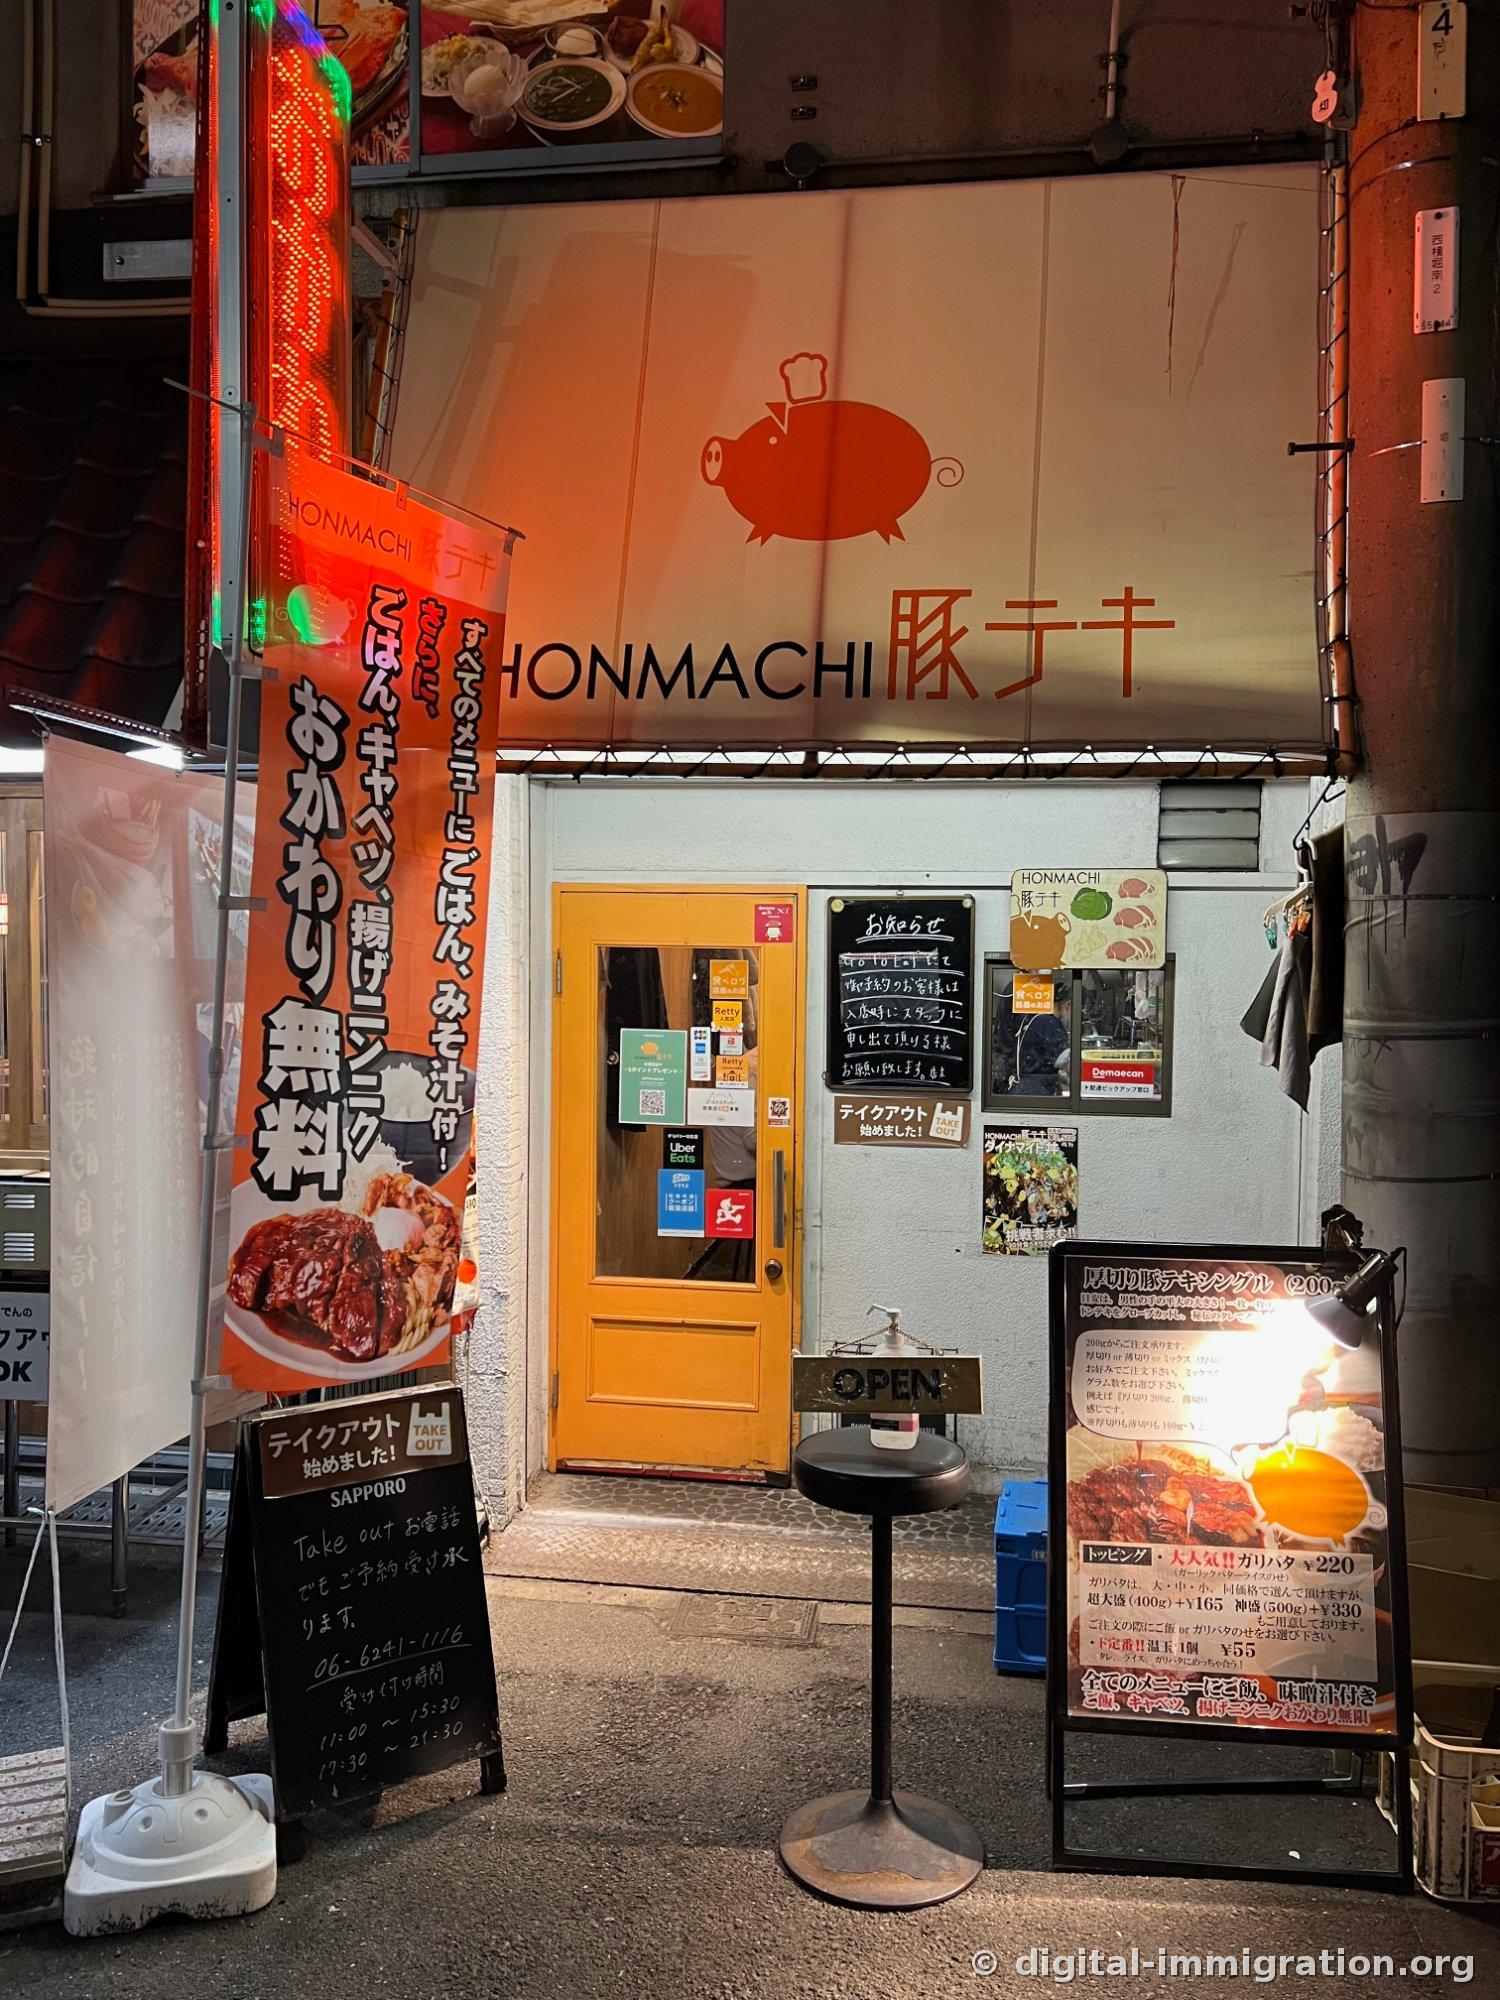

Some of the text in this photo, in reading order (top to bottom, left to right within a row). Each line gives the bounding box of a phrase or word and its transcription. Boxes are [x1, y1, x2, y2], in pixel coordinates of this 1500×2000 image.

[1431, 9, 1454, 36] 4
[289, 490, 412, 563] HONMACHI
[500, 585, 1176, 701] HONMACHI 豚テキ
[1021, 871, 1101, 885] HONMACHI
[1021, 890, 1062, 908] 豚テキ
[865, 912, 946, 936] お知らせ
[255, 678, 348, 1194] おかわり無料
[714, 1007, 740, 1017] Retty
[722, 1057, 743, 1067] Retty
[1092, 1067, 1145, 1079] Demaecan
[839, 1103, 928, 1122] テイクアウト
[935, 1114, 960, 1129] TAKE
[859, 1123, 923, 1138] 始めました!
[935, 1126, 957, 1138] OUT
[984, 1132, 1022, 1141] HONMACHI
[670, 1142, 696, 1153] Uber
[670, 1153, 696, 1163] Eats
[832, 1368, 942, 1401] OPEN
[268, 1412, 401, 1459] テイクアウト
[412, 1424, 447, 1436] TAKE
[415, 1438, 444, 1451] OUT
[302, 1444, 397, 1479] 始めました!
[330, 1477, 407, 1508] SAPPORO
[292, 1505, 461, 1562] Take out お電話
[1087, 1546, 1149, 1564] トッピング
[1303, 1555, 1355, 1575] ¥220
[1178, 1626, 1190, 1634] or
[314, 1625, 464, 1679] 06-6241-1116
[1219, 1641, 1256, 1658] ¥55
[320, 1723, 367, 1751] 11:00
[410, 1695, 460, 1723] 15:30
[409, 1721, 463, 1748] 21:30
